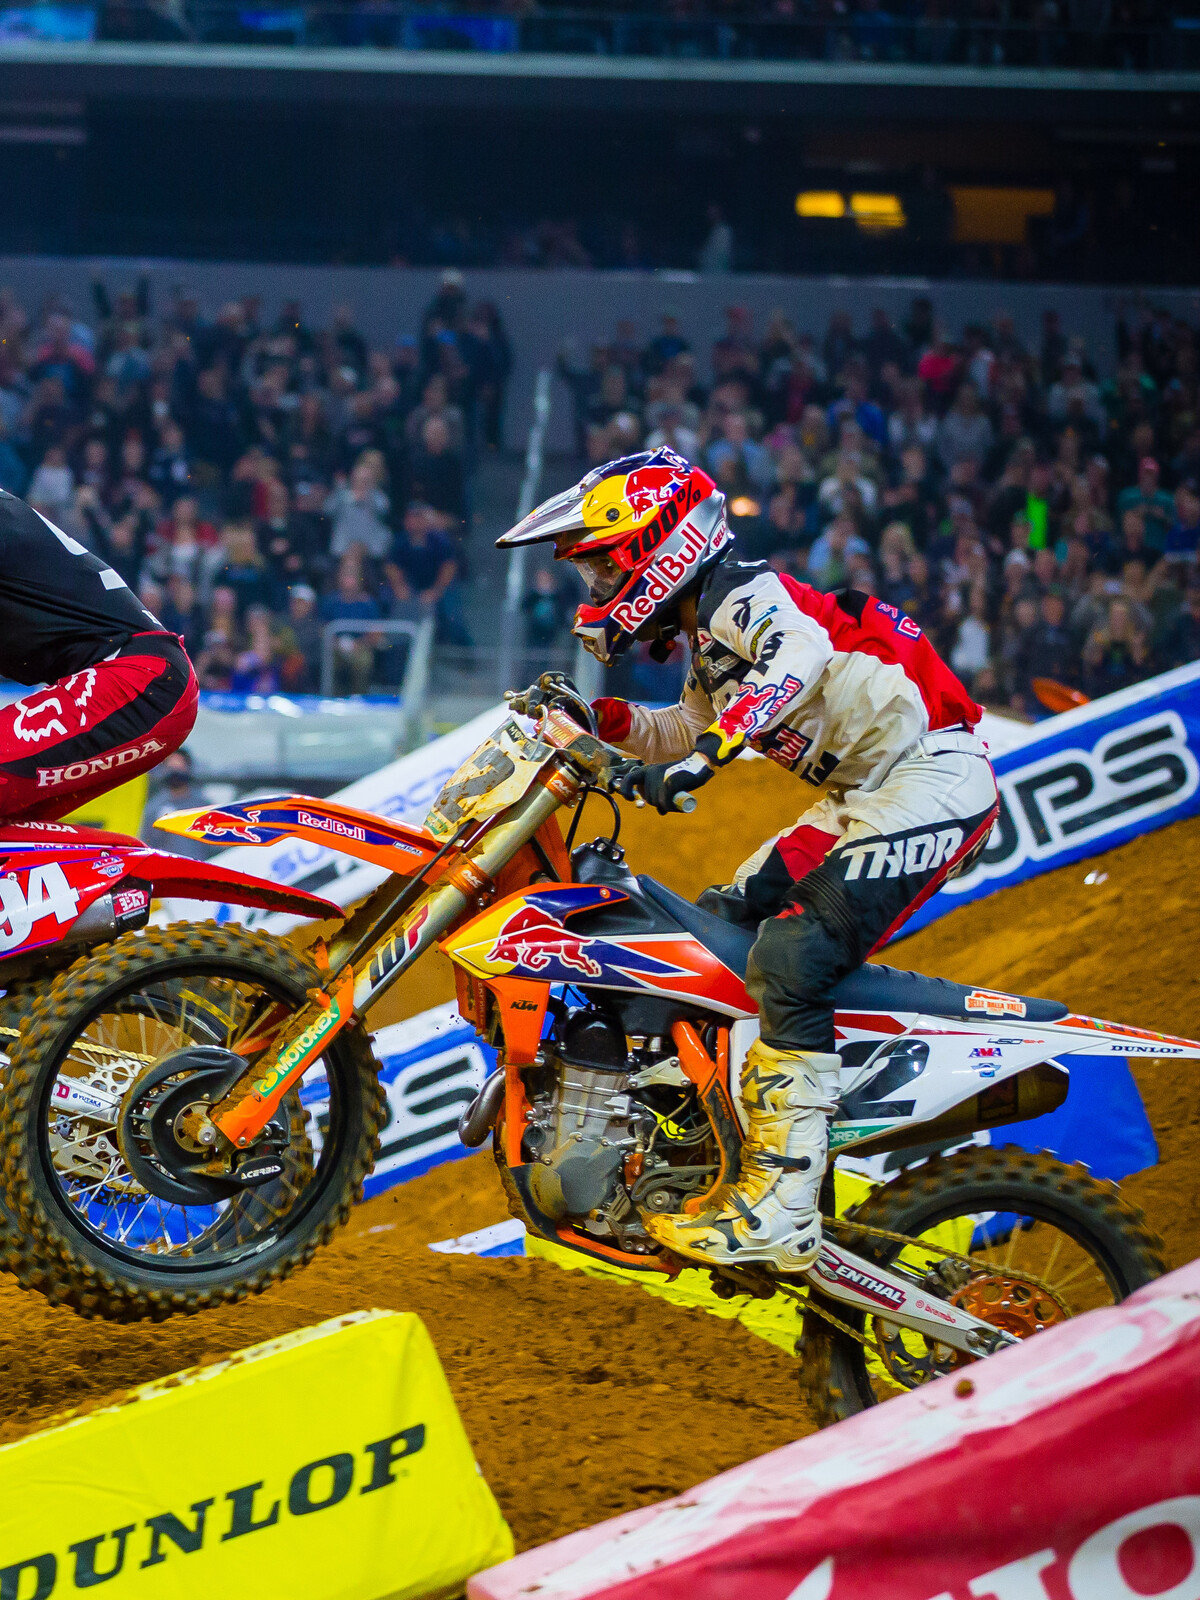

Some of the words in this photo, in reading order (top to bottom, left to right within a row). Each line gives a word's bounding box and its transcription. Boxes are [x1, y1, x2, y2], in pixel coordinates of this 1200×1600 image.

[625, 479, 702, 567] 100%
[712, 522, 727, 549] BELL
[612, 563, 670, 634] Red
[660, 521, 708, 587] Bull
[36, 738, 167, 788] HONDA
[298, 811, 332, 831] Red
[333, 821, 366, 842] Bull
[839, 827, 964, 881] THOR
[510, 1000, 539, 1012] KTM
[277, 1009, 339, 1075] MOTOREX
[967, 1047, 1003, 1058] AMA
[1111, 1045, 1184, 1055] DUNLOP
[79, 1093, 102, 1108] YUTAKA
[829, 1130, 862, 1142] OREX
[241, 1165, 282, 1181] ACERBIS
[925, 1304, 957, 1325] brembo
